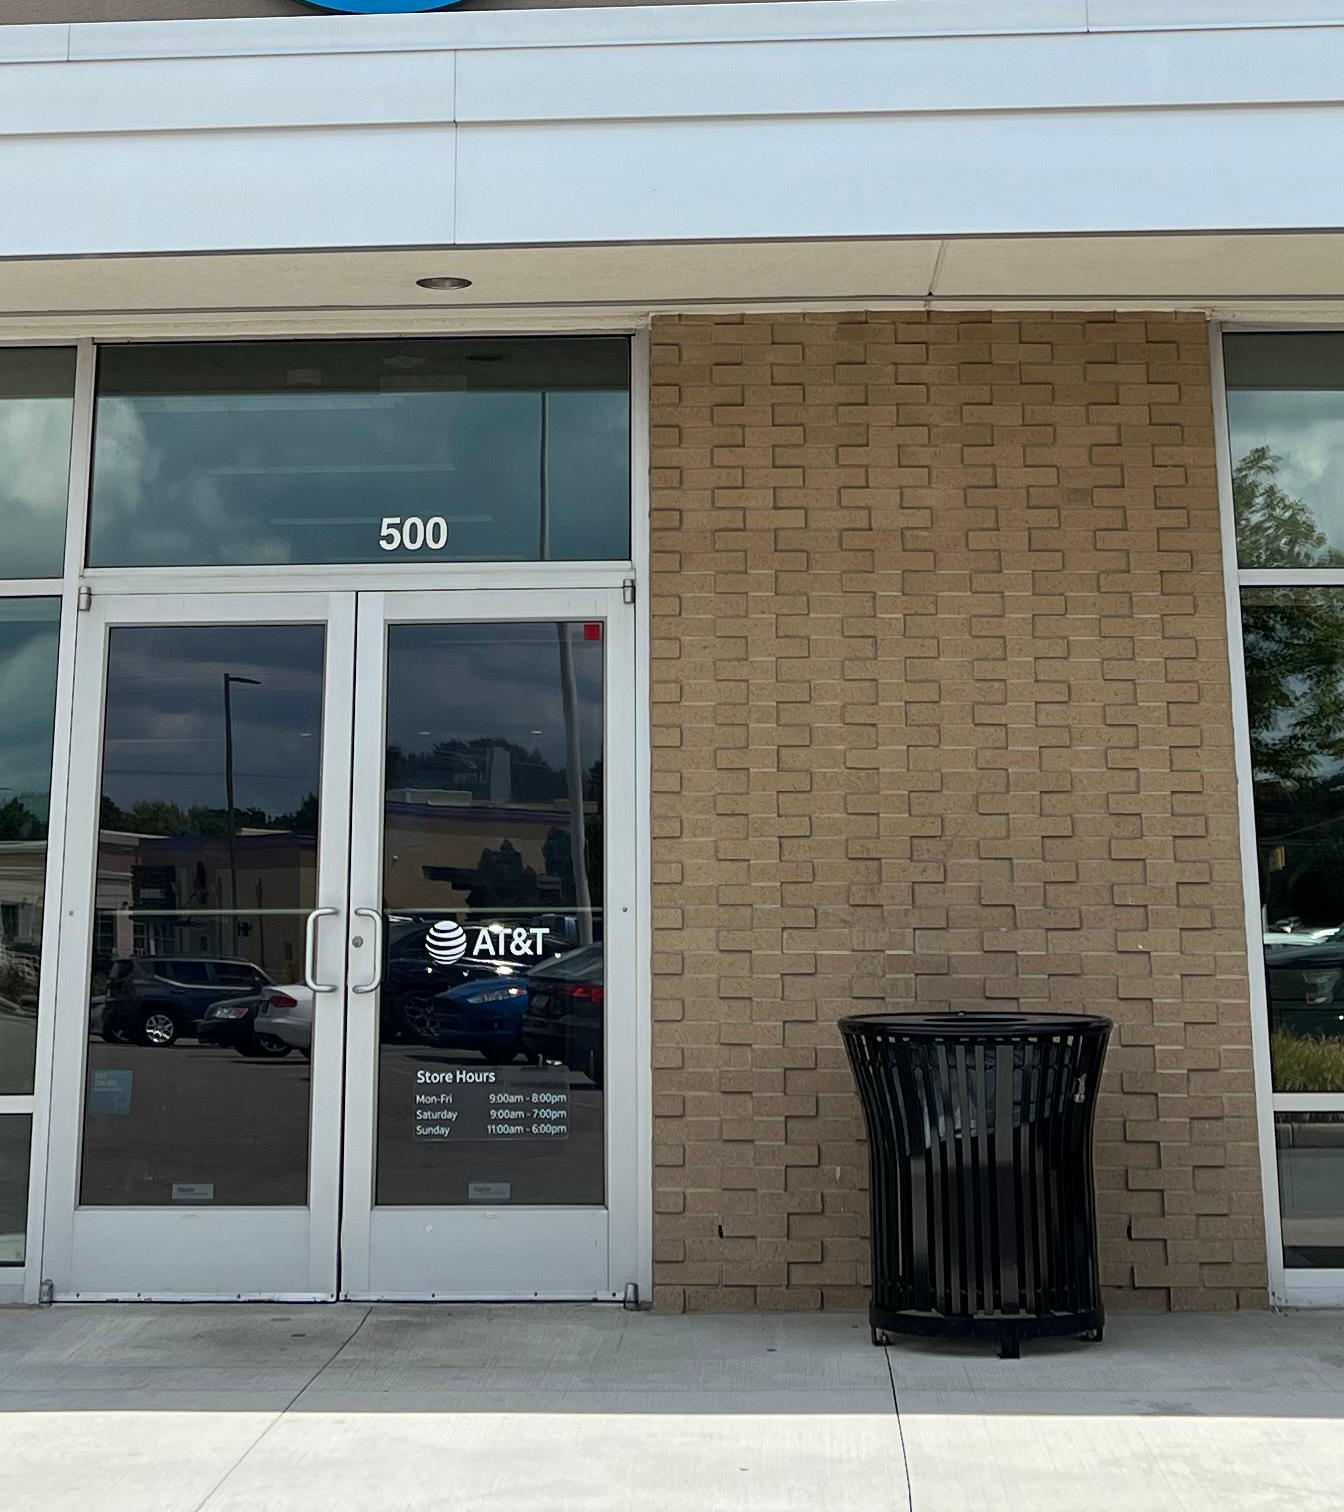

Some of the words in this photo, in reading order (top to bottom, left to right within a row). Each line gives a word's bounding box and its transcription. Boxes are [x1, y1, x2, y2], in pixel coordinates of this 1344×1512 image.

[379, 517, 448, 551] 500
[472, 927, 550, 956] AT&T
[416, 1070, 454, 1083] Store
[456, 1070, 496, 1083] Hours
[415, 1093, 453, 1104] Mon-Fri
[489, 1093, 524, 1104] 9:00am
[531, 1093, 567, 1105] 8:00pm
[416, 1110, 458, 1121] Saturday
[490, 1109, 525, 1120] 9:00am
[532, 1109, 567, 1121] 7:00pm
[416, 1125, 451, 1137] Sunday
[487, 1124, 524, 1134] 11:00am
[531, 1124, 567, 1135] 6:00pm
